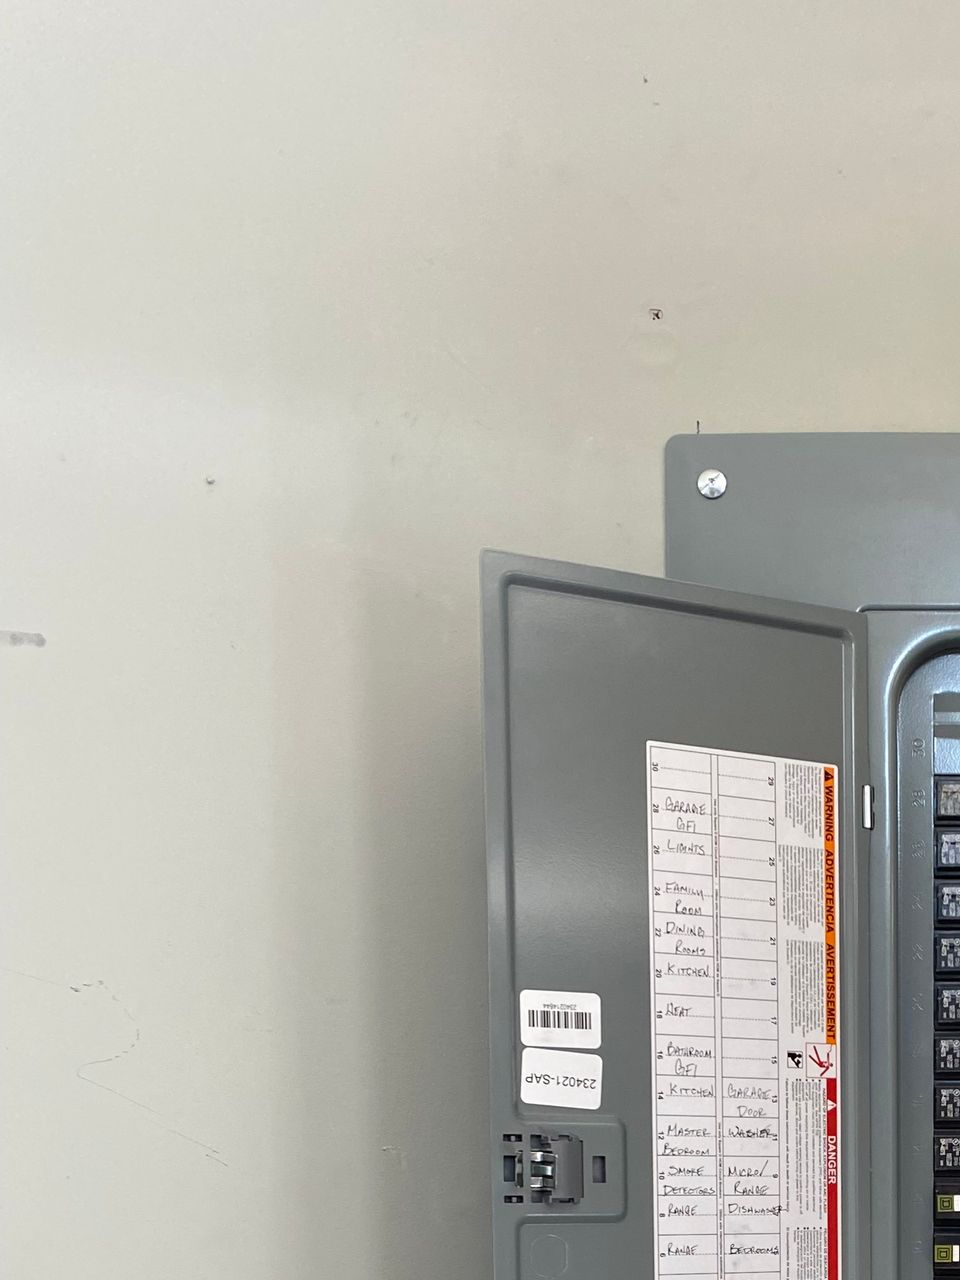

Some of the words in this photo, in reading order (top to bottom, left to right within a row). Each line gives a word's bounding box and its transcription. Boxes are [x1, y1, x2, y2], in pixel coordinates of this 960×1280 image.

[652, 762, 659, 772] 30
[767, 776, 774, 786] 29
[652, 804, 659, 813] 28
[665, 796, 706, 815] GARAGE
[824, 785, 834, 842] WARNING
[676, 817, 696, 833] GFI
[768, 817, 775, 826] 27
[653, 845, 660, 855] 26
[667, 839, 706, 856] LIGHTS
[769, 857, 775, 867] 25
[654, 886, 661, 896] 24
[665, 881, 704, 900] FAMILY
[825, 849, 835, 933] ADVERTENCIA
[675, 899, 703, 915] ROOM
[769, 897, 776, 907] 23
[655, 928, 662, 938] 22
[665, 921, 705, 938] DINING
[770, 937, 776, 946] 21
[655, 968, 662, 978] 20
[667, 962, 710, 978] KITCHEN
[770, 977, 777, 986] 19
[826, 943, 836, 1040] AVERTISSEMENT
[656, 1010, 663, 1019] 18
[665, 1002, 692, 1017] HEAT
[771, 1016, 777, 1026] 17
[657, 1051, 664, 1060] 16
[667, 1041, 713, 1059] BATHROOM
[770, 1056, 777, 1065] 15
[675, 1058, 698, 1078] GFI
[525, 1073, 597, 1090] 234021-SAP
[658, 1091, 664, 1100] 14
[669, 1082, 715, 1098] KITCHEN
[727, 1083, 772, 1100] GARAGE
[771, 1095, 778, 1104] 13
[737, 1105, 767, 1117] DOOR
[658, 1131, 665, 1140] 12
[667, 1124, 712, 1137] MASTER
[728, 1124, 775, 1138] WASHER
[772, 1134, 778, 1142] 11
[662, 1143, 710, 1156] BEDROOM
[828, 1135, 837, 1184] DANGER
[668, 1166, 705, 1177] SMOKE
[728, 1160, 769, 1178] MICRO/
[659, 1172, 665, 1181] 10
[664, 1184, 716, 1197] DETECTORS
[733, 1181, 770, 1196] RANGE
[668, 1203, 699, 1217] RANGE
[667, 1242, 699, 1256] RANGE
[729, 1243, 779, 1255] BEDROOMS
